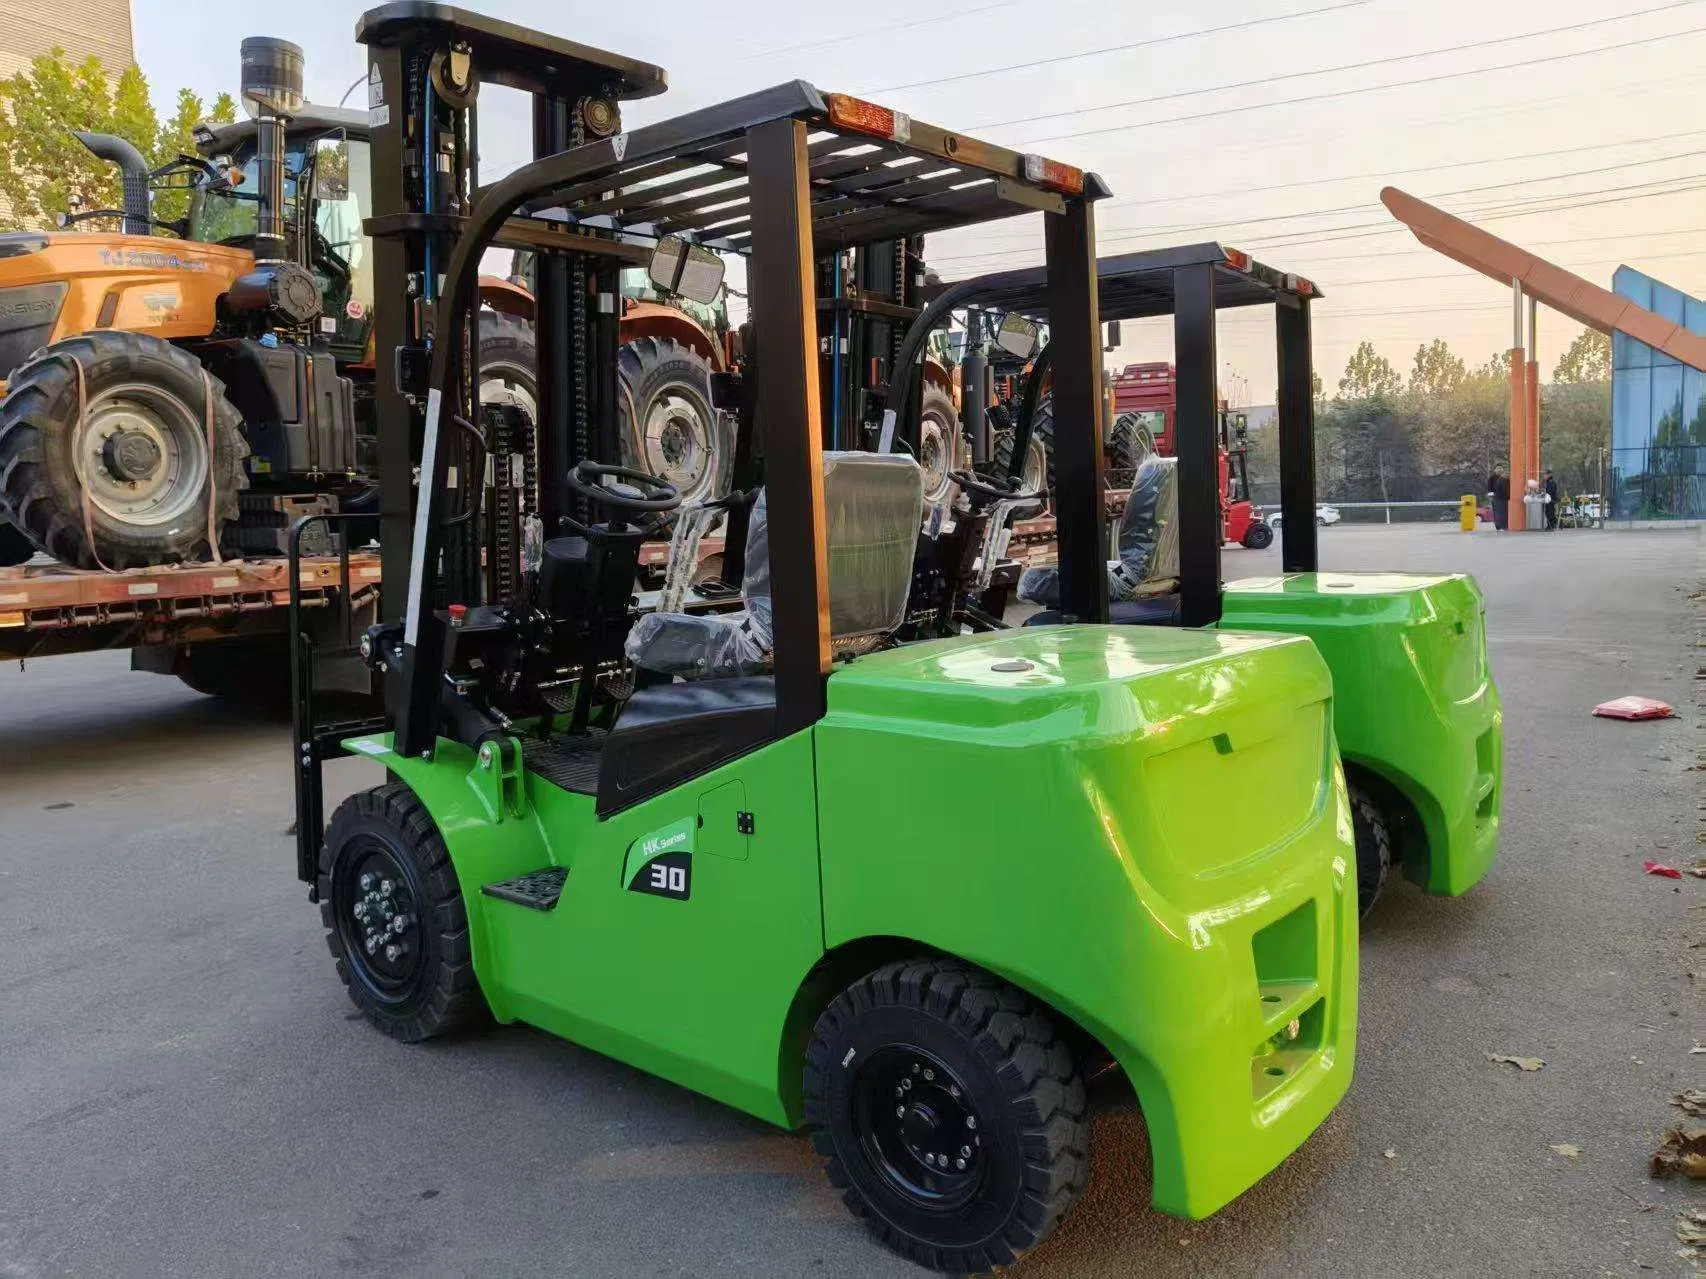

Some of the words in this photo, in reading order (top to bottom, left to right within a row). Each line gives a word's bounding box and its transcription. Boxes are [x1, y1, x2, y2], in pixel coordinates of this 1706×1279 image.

[643, 837, 659, 856] HK
[660, 832, 686, 848] Series
[651, 864, 686, 892] 30
